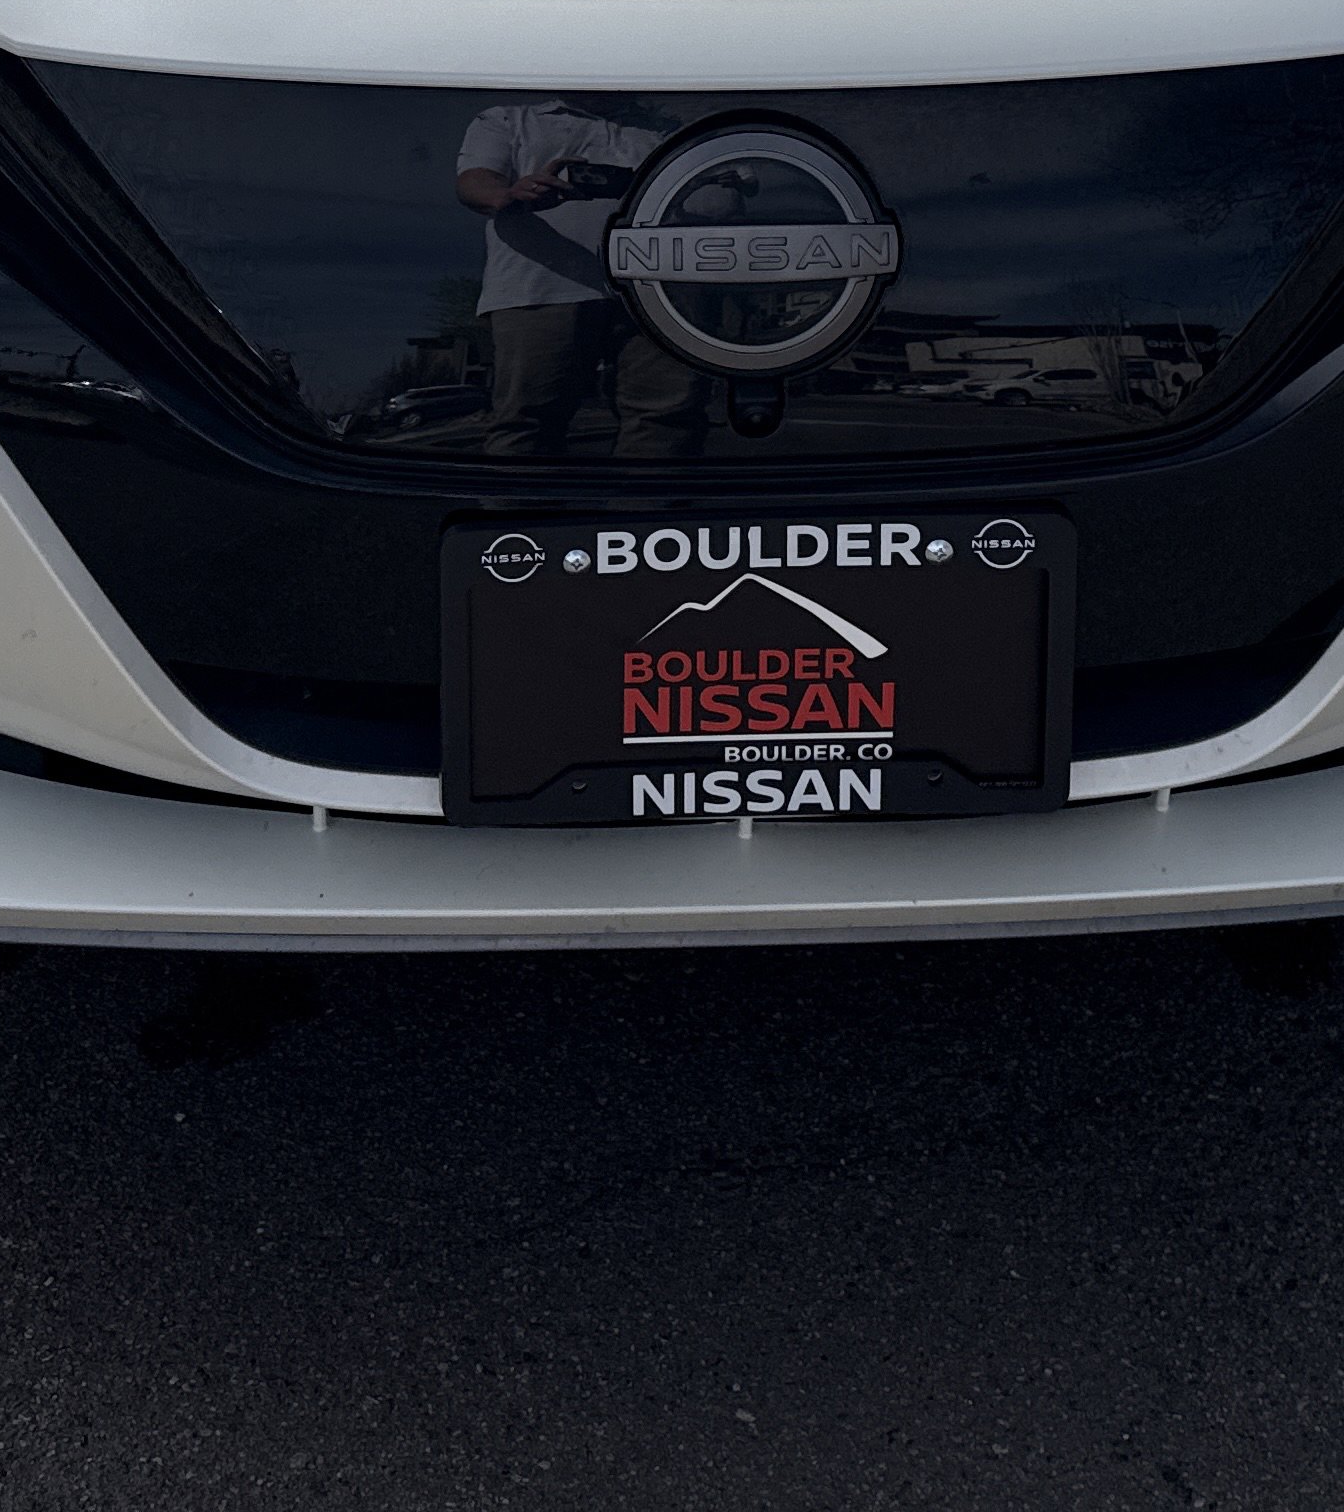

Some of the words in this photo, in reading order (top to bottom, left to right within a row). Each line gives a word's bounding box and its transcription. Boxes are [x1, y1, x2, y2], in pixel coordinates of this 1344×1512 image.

[617, 233, 891, 271] NISSAN
[481, 552, 546, 564] NISSAN
[597, 523, 921, 574] BOULDER
[971, 539, 1036, 549] NISSAN
[624, 648, 855, 683] BOULDER
[624, 682, 895, 733] NISSAN
[858, 743, 893, 761] CO
[632, 768, 882, 817] NISSAN
